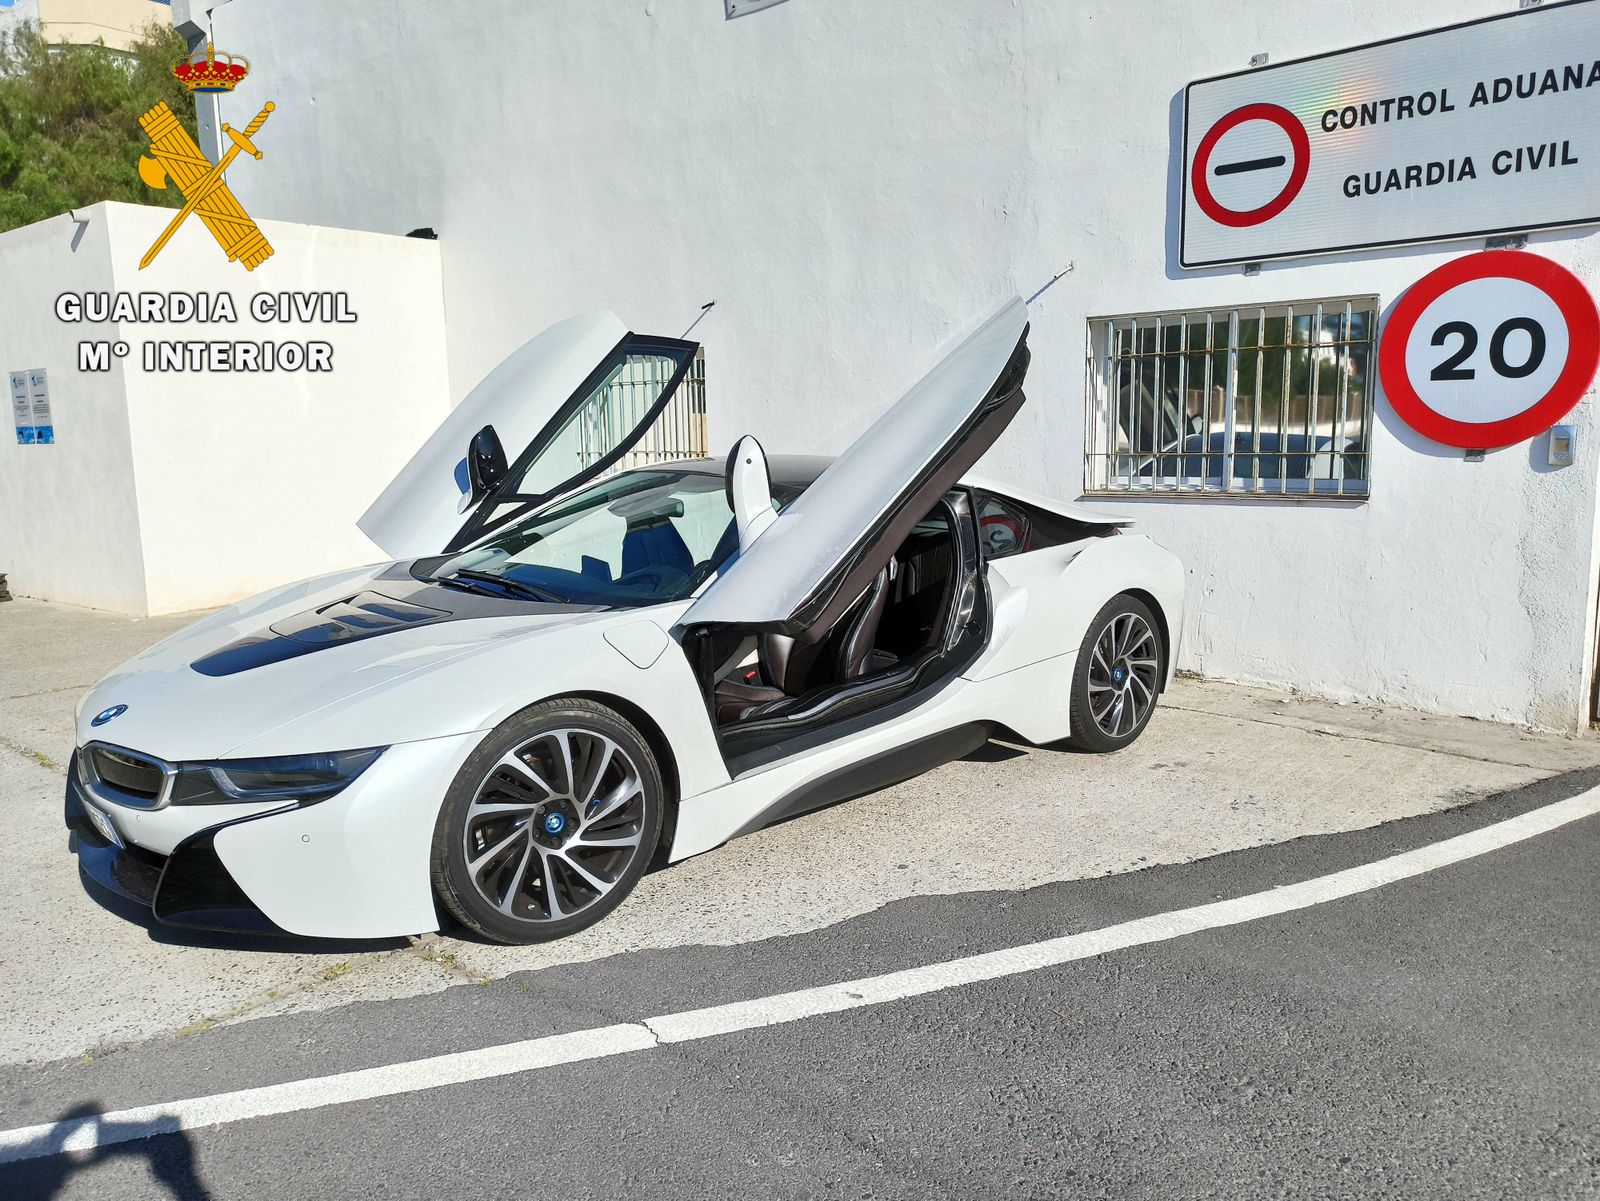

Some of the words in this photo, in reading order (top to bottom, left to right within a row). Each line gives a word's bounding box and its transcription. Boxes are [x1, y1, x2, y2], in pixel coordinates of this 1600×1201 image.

[1321, 88, 1455, 133] CONTROL
[1342, 156, 1477, 198] GUARDIA
[1491, 140, 1579, 176] CIVIL
[1430, 316, 1547, 382] 20
